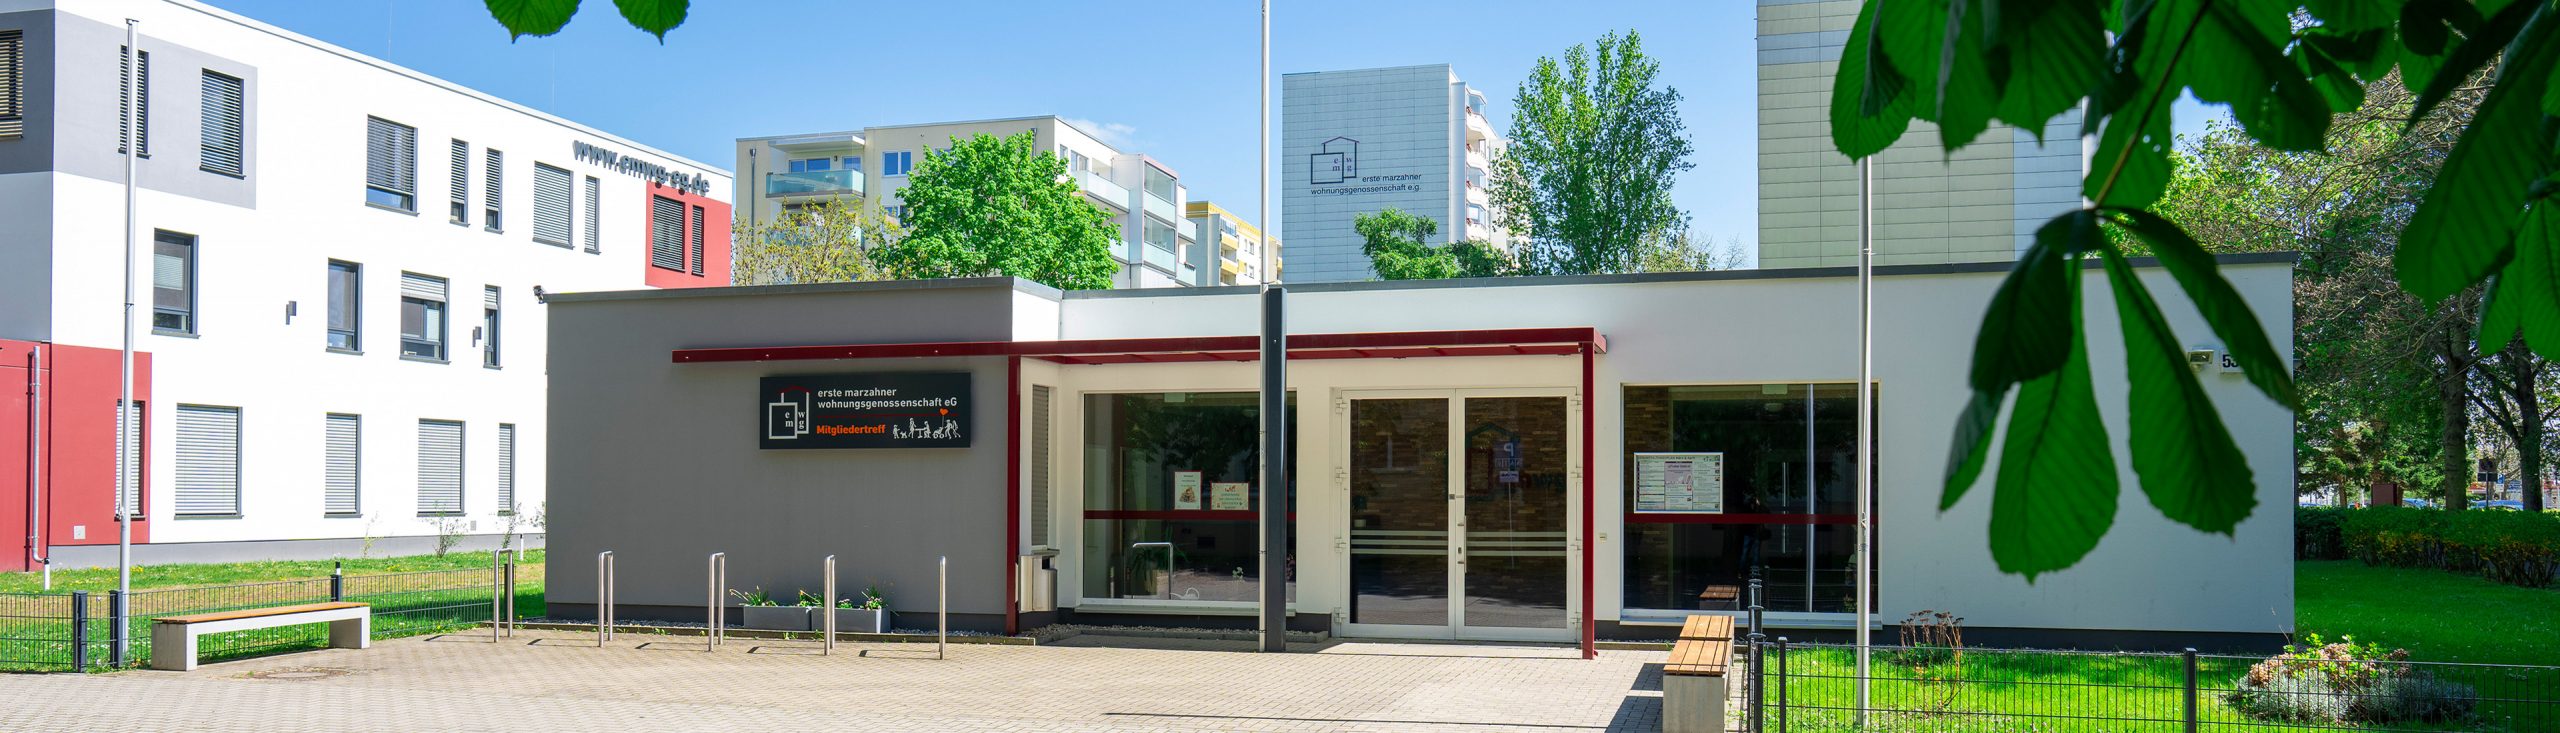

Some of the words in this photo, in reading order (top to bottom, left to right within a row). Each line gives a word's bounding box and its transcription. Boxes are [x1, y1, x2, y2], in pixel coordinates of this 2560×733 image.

[572, 139, 710, 197] www.emwg-eg.de
[1382, 173, 1422, 181] marzahner
[1311, 184, 1406, 195] wohnungsgenossenschaft
[1407, 184, 1422, 192] e.g.
[817, 388, 842, 398] erste
[844, 387, 897, 398] marzahner
[817, 397, 942, 411] wohnungsgenossenschaft
[944, 397, 957, 407] eG
[785, 411, 790, 419] e
[798, 411, 805, 419] w
[785, 420, 794, 428] m
[799, 420, 805, 429] g
[816, 424, 887, 437] Mitgliedertreff
